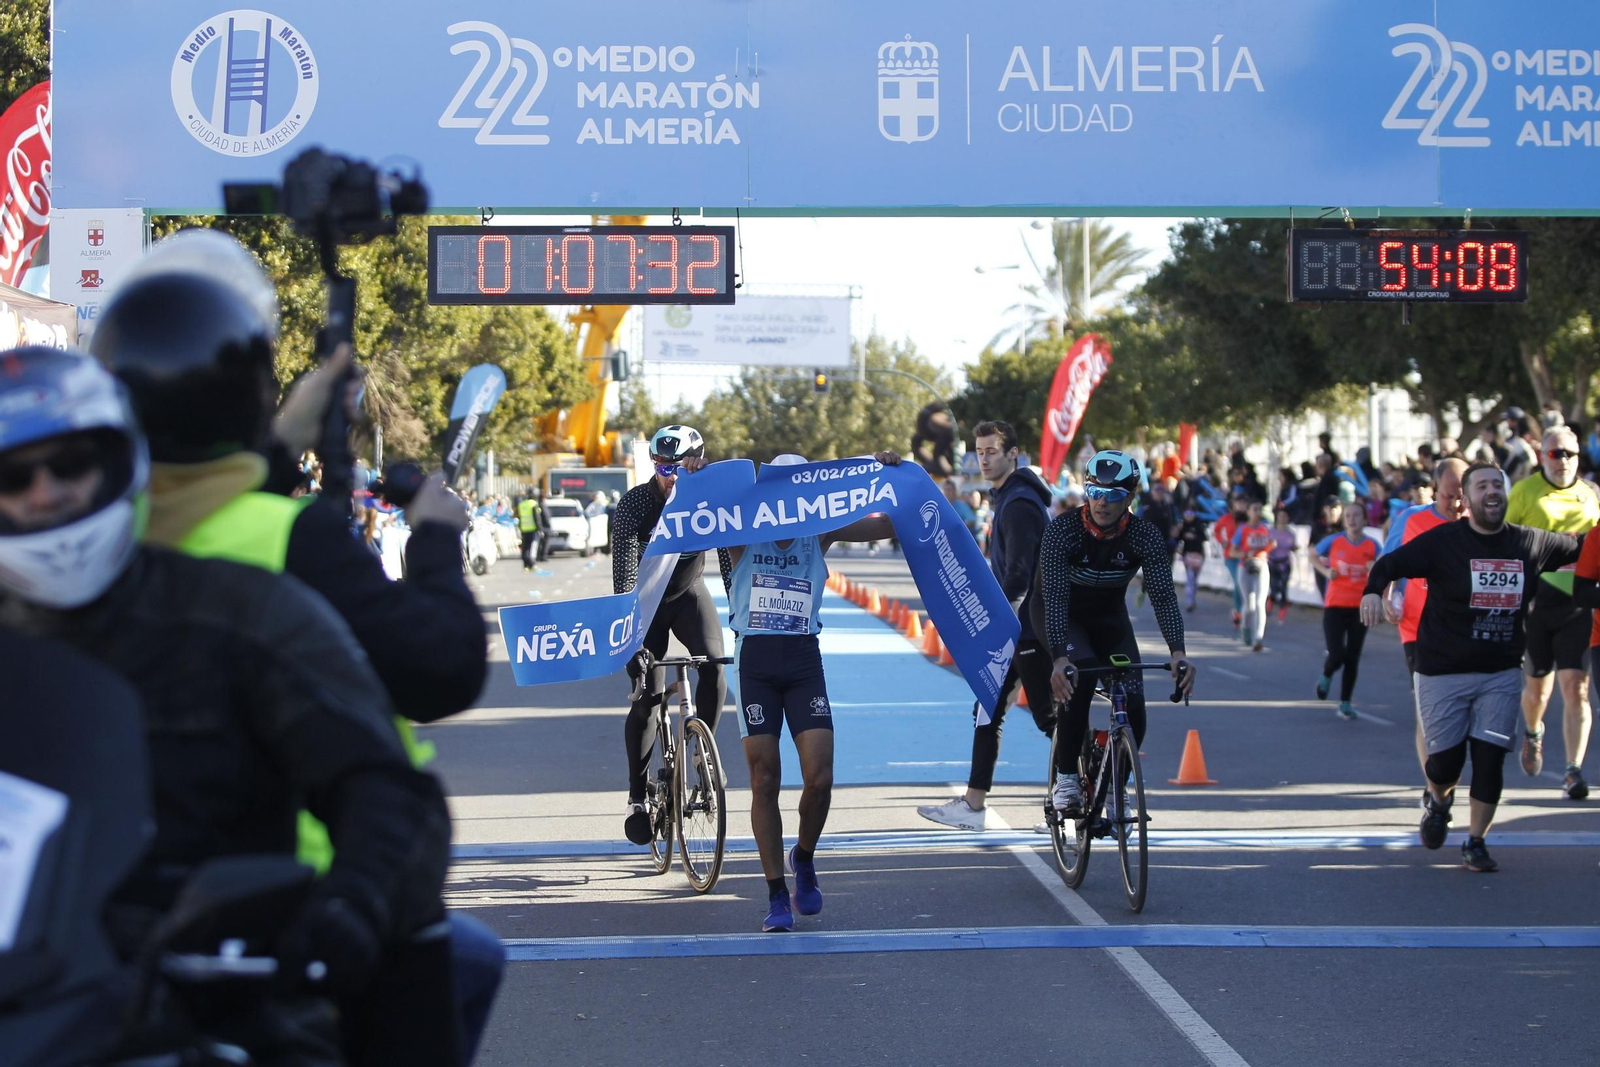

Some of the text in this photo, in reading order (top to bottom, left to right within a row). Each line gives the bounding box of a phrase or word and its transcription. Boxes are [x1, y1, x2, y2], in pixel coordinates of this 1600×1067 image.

[180, 26, 314, 80] Medio Maratón
[576, 45, 696, 72] MEDIO
[998, 34, 1265, 92] ALMERÍA
[576, 73, 760, 109] MARATÓN
[576, 110, 741, 145] ALMERÍA
[997, 103, 1134, 133] CIUDAD
[189, 118, 301, 153] CIUDAD DE ALMERÍA
[80, 249, 112, 257] ALMERÍA
[1377, 241, 1518, 292] 54:08
[76, 305, 99, 320] NE
[447, 372, 501, 467] POWERADE
[791, 460, 884, 485] 03/02/2019
[649, 476, 898, 544] ATÓN ALMERÍA
[752, 553, 800, 569] nerja
[1478, 572, 1519, 587] 5294
[758, 596, 804, 613] EL MOUAZIZ
[779, 590, 785, 599] 1
[533, 623, 557, 632] GRUPO
